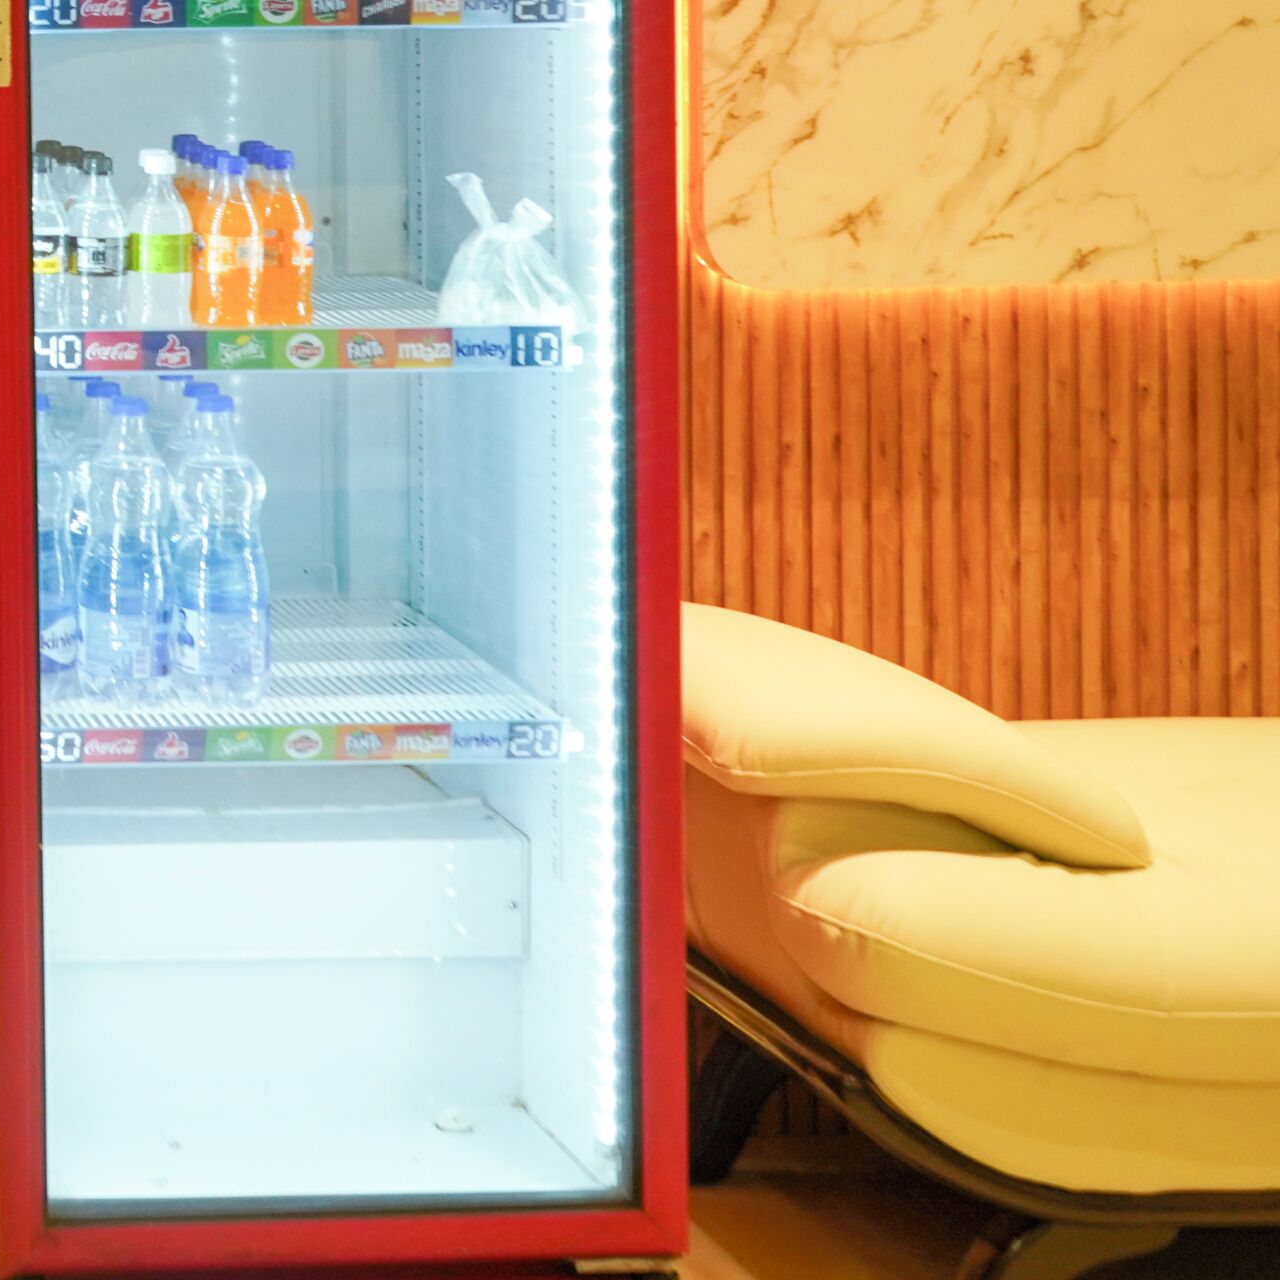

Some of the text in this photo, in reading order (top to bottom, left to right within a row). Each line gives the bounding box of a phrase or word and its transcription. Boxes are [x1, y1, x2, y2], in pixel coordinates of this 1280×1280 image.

[34, 334, 82, 369] 40
[455, 339, 507, 359] kinley
[517, 332, 558, 366] 10
[510, 724, 559, 757] 20
